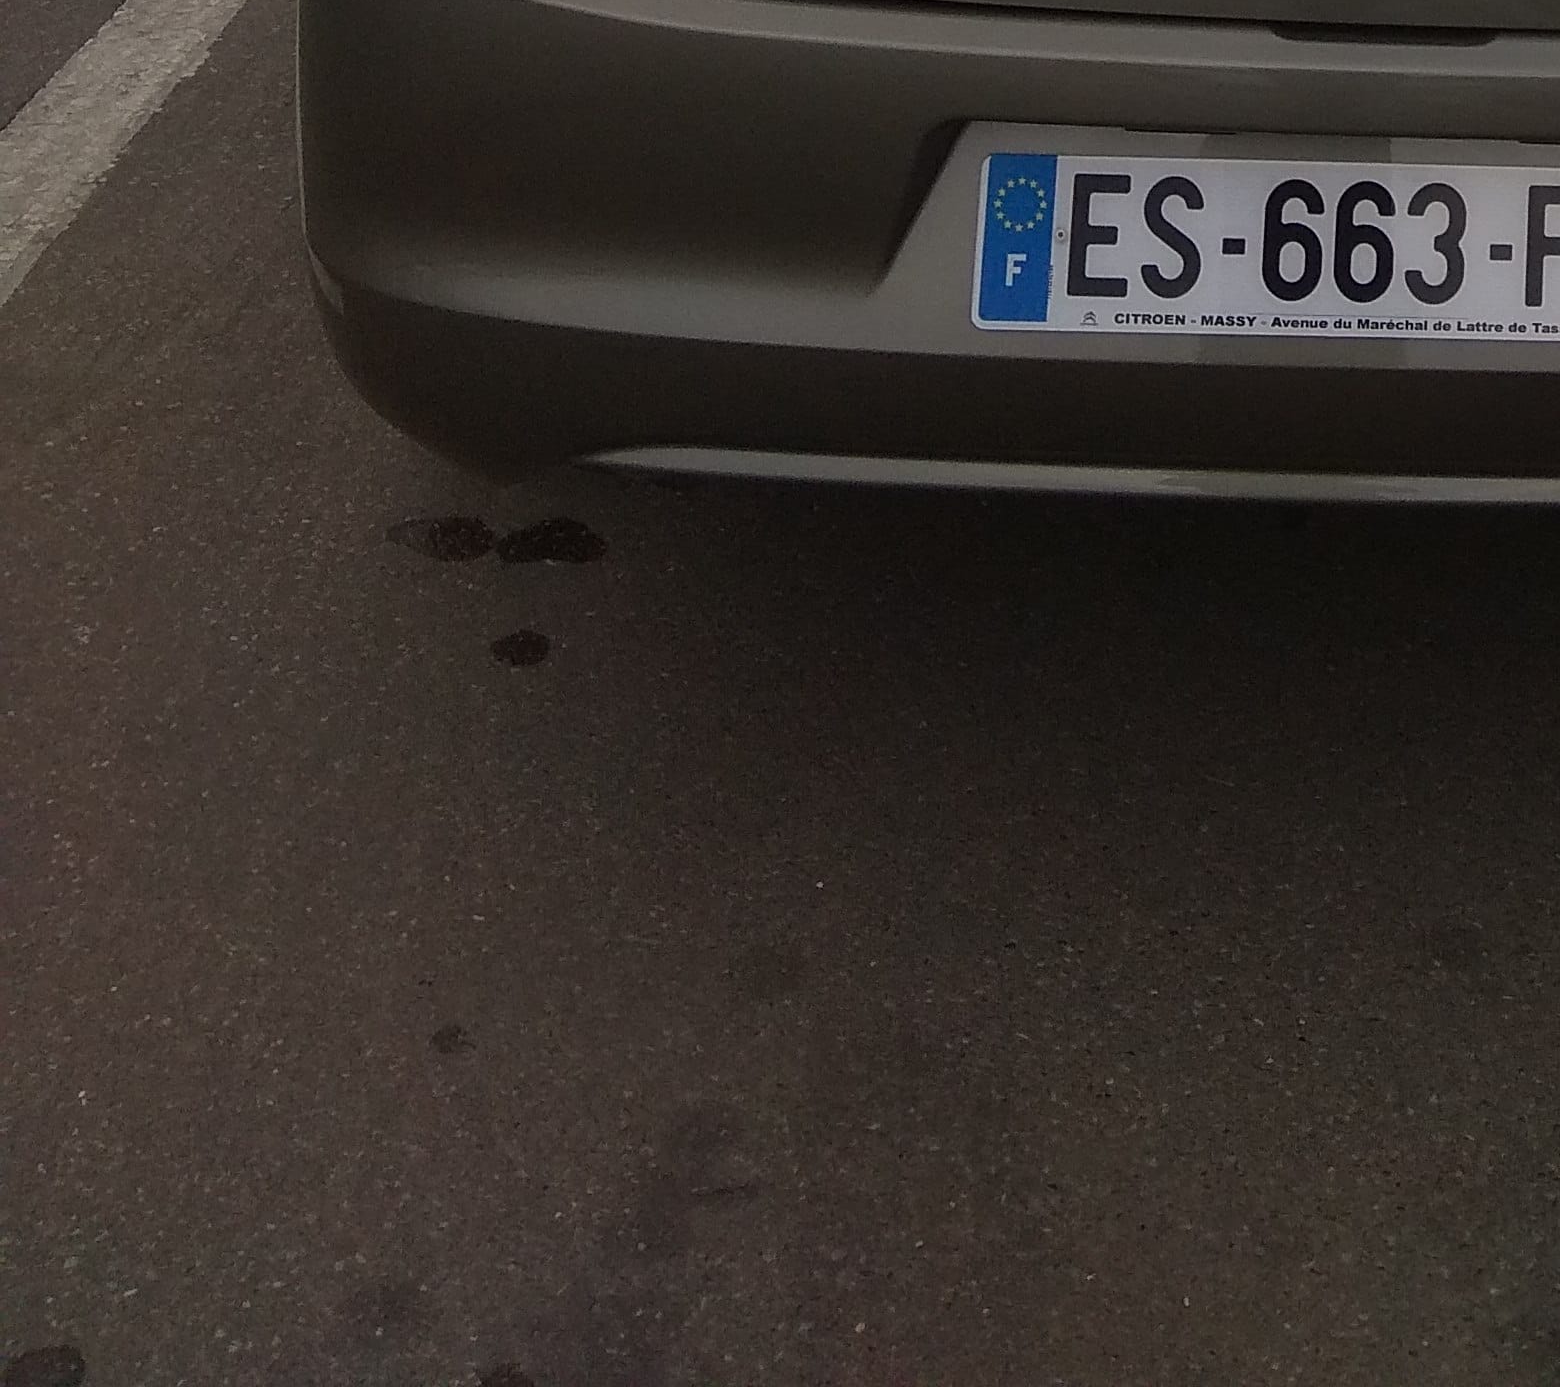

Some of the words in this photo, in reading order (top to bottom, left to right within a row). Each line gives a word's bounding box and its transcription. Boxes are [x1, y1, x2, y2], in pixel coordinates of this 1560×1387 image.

[1005, 253, 1027, 287] F
[1114, 312, 1186, 326] CITROEN
[1200, 314, 1257, 328] MASSY
[1271, 316, 1328, 329] Avenue
[1333, 317, 1352, 330] du
[1357, 317, 1428, 332] Maréchal
[1433, 319, 1452, 332] de
[1457, 320, 1504, 333] Lattre
[1508, 322, 1528, 334] de
